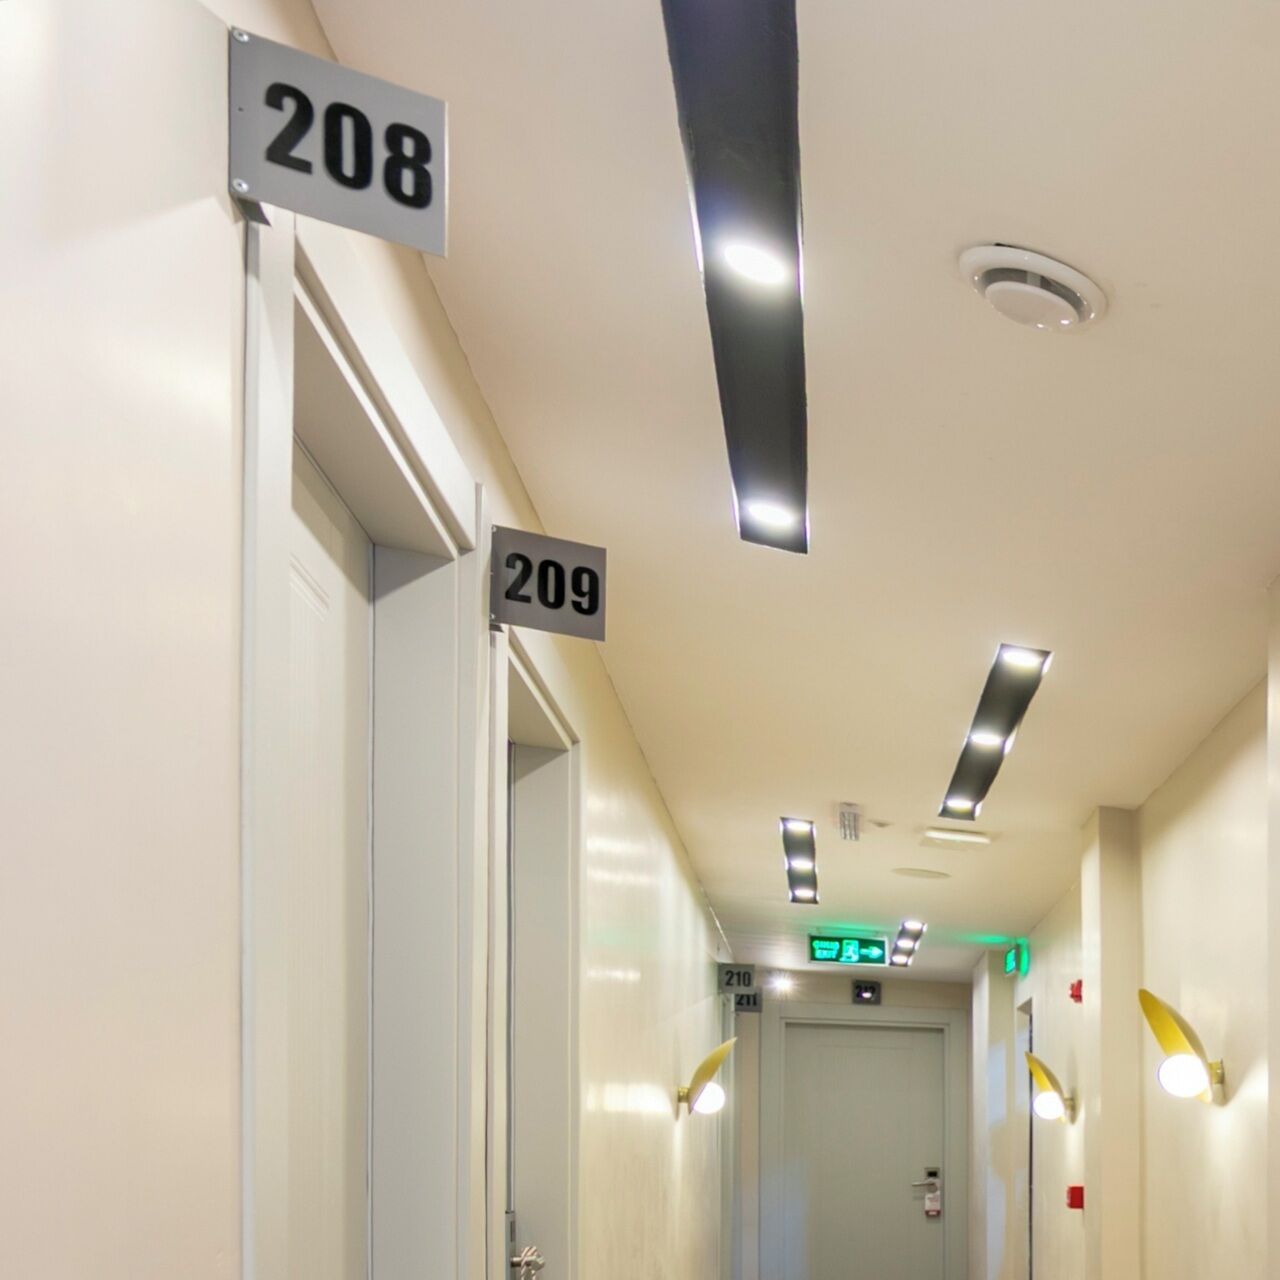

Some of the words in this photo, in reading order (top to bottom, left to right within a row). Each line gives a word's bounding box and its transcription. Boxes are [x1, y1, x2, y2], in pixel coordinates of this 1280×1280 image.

[265, 82, 433, 210] 208
[504, 552, 600, 616] 209
[725, 970, 751, 987] 210
